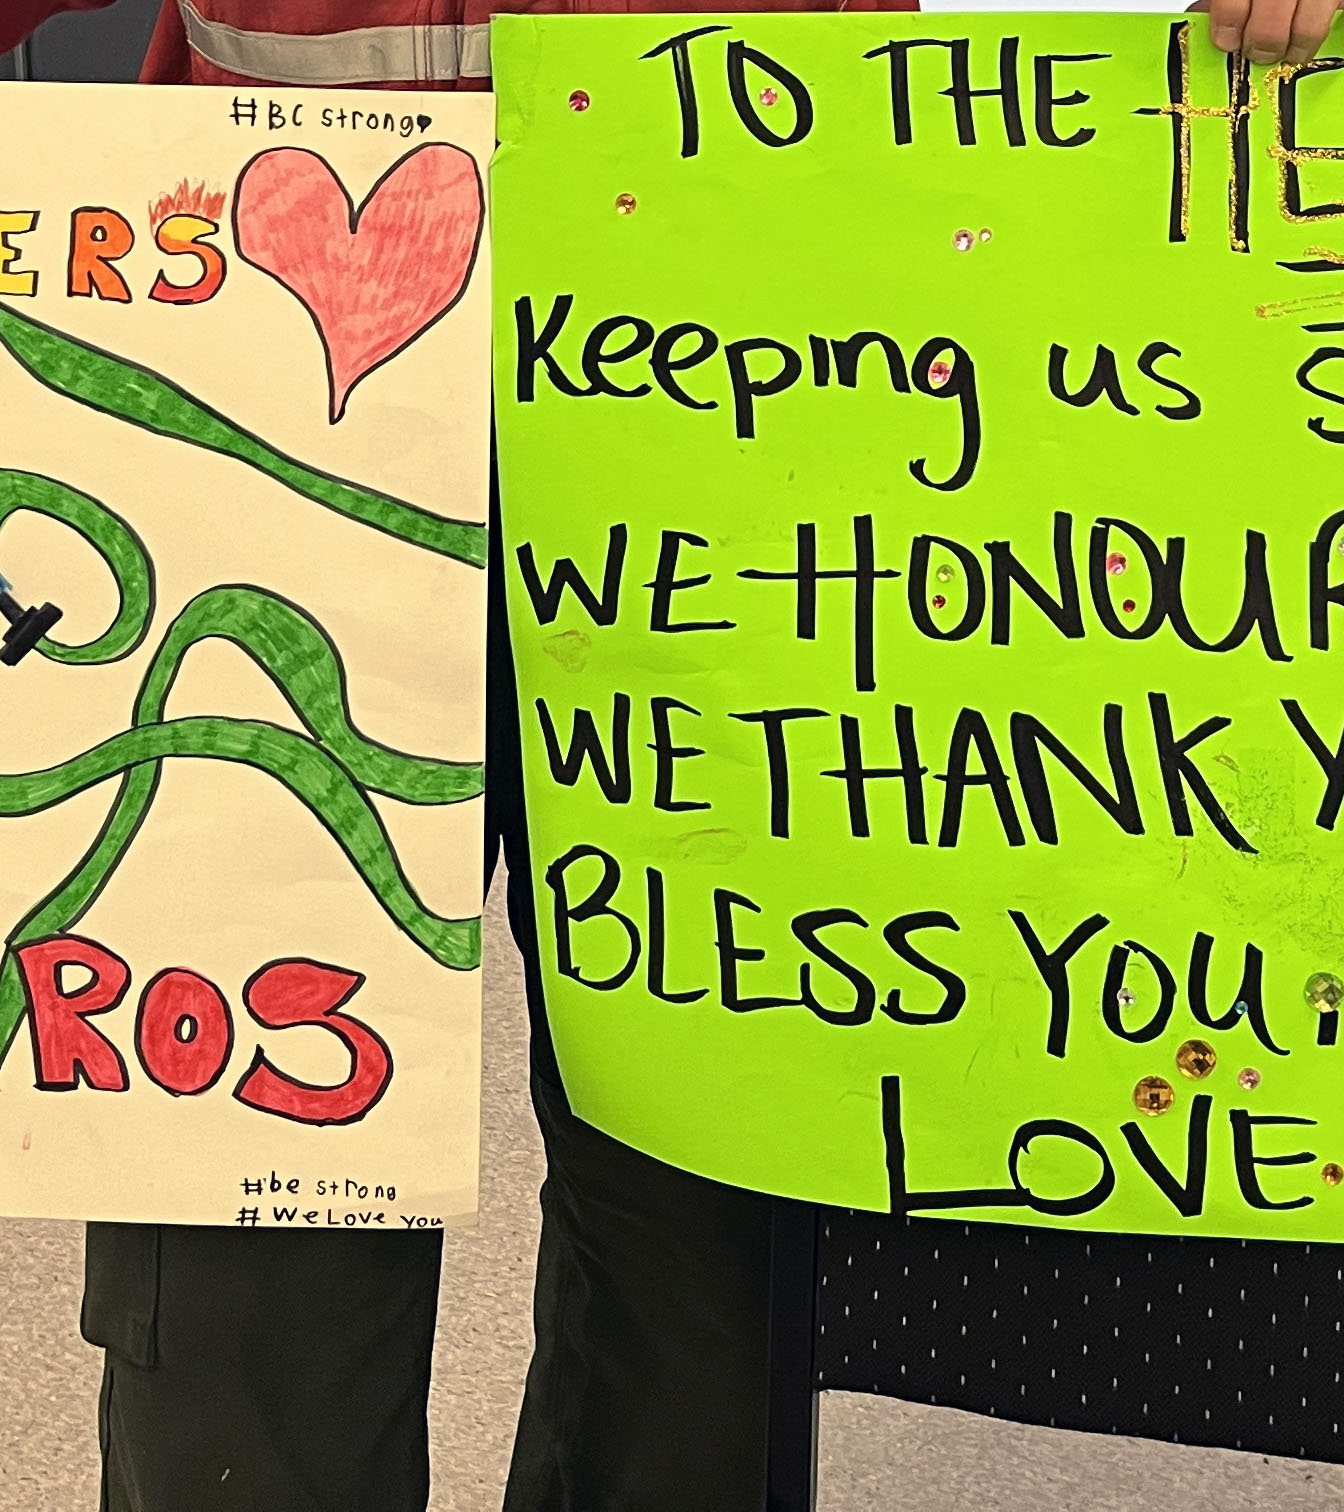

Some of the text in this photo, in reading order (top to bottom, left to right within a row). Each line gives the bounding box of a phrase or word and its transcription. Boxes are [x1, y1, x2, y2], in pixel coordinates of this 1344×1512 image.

[638, 25, 815, 158] TO
[862, 36, 1113, 148] THE
[514, 293, 981, 491] Keeping
[1049, 340, 1202, 421] us
[516, 522, 737, 635] WE
[535, 691, 713, 811] WE
[728, 691, 1260, 855] THANK
[544, 844, 968, 1026] BLESS
[881, 1074, 1318, 1217] LOVE
[400, 1215, 443, 1228] you
